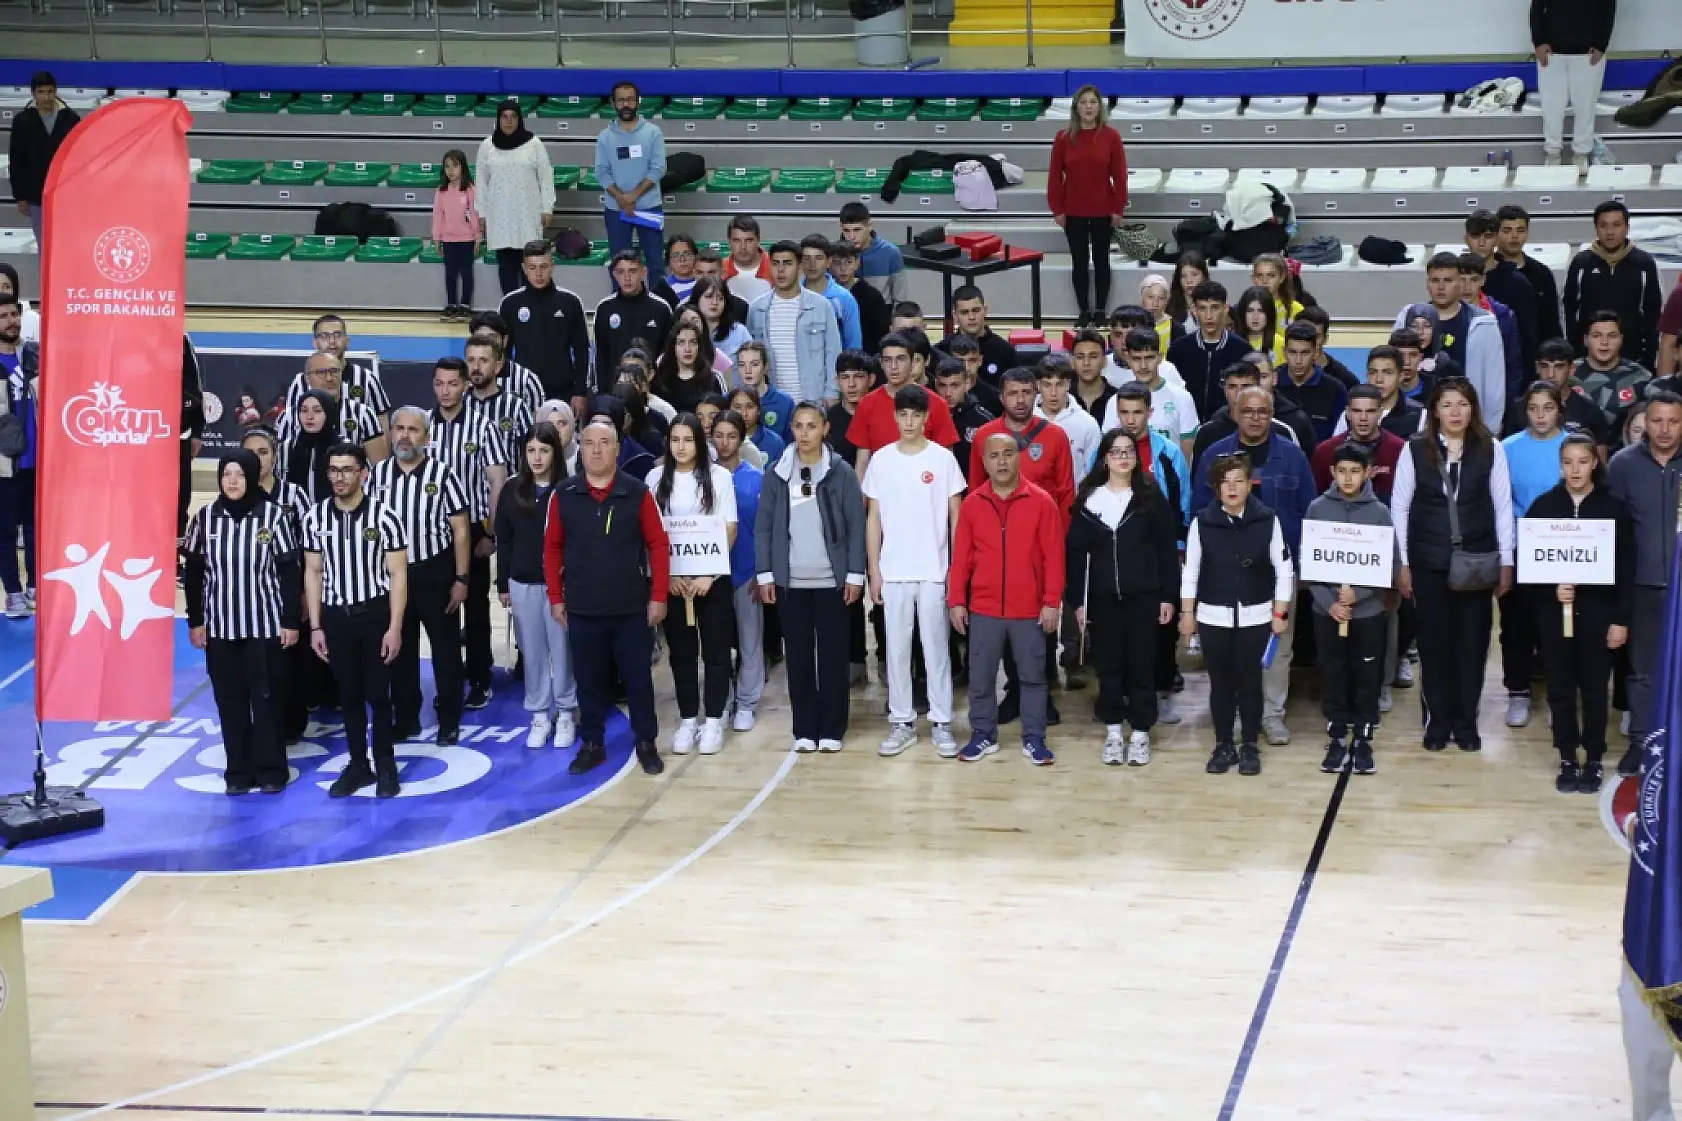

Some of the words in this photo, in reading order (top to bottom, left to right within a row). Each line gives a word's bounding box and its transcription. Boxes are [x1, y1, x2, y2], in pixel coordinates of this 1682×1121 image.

[66, 288, 91, 299] T.C.
[94, 288, 154, 303] GENÇLİK
[158, 290, 176, 301] VE
[66, 303, 101, 314] SPOR
[104, 304, 176, 316] BAKANLIĞI
[1333, 527, 1363, 536] MUĞLA
[1550, 523, 1582, 532] MUĞLA
[669, 543, 721, 556] TALYA
[1534, 545, 1598, 562] DENİZLİ
[1313, 548, 1381, 567] BURDUR
